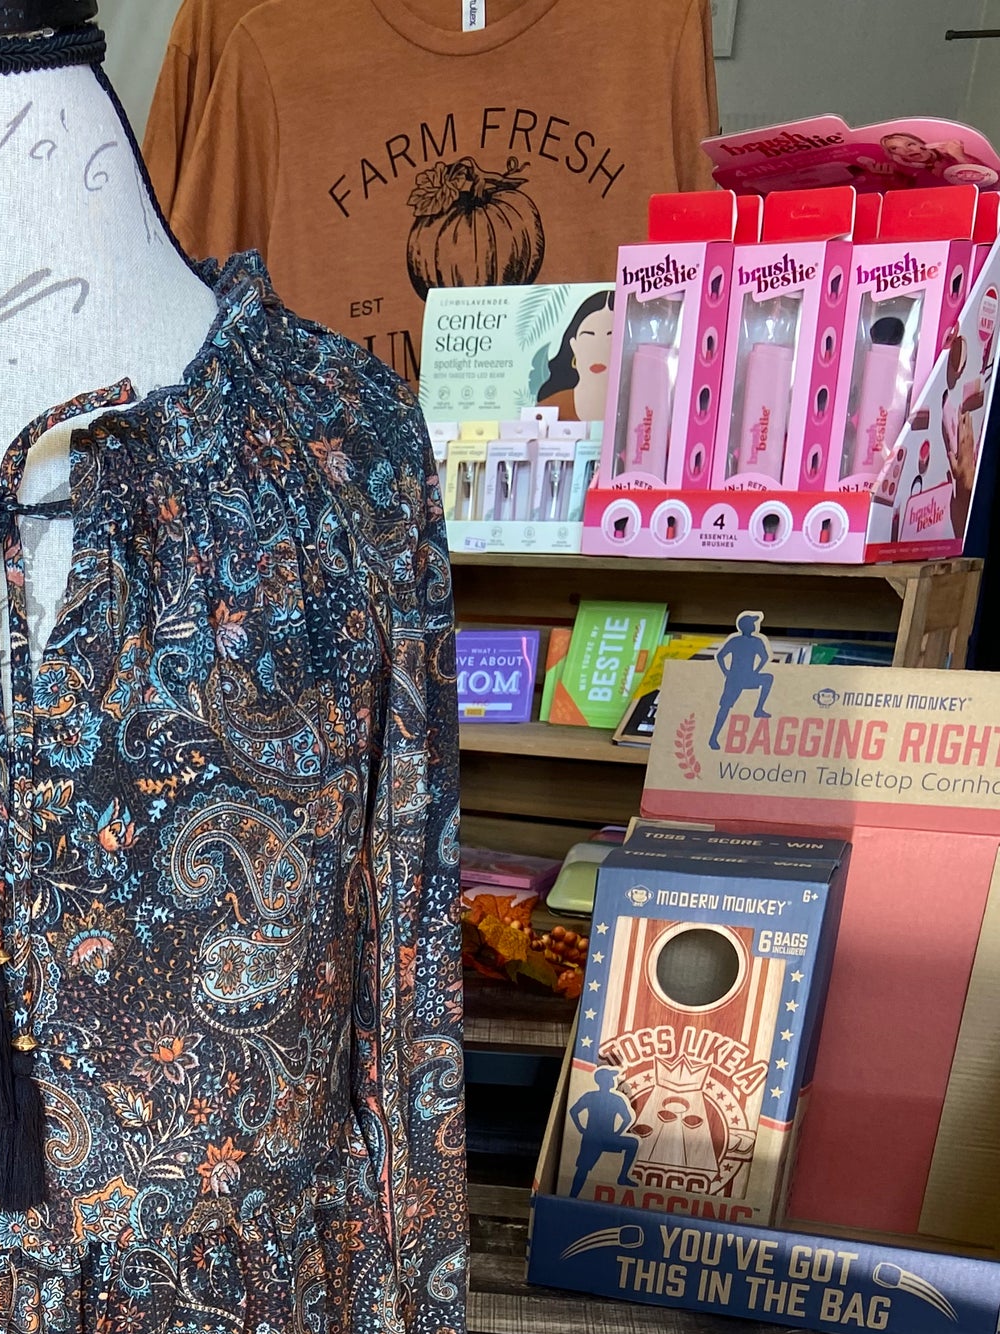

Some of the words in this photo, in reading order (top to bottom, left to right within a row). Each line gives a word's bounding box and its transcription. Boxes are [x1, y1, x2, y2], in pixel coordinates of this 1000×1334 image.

[327, 112, 458, 219] FARM
[479, 107, 626, 199] FRESH
[622, 254, 677, 286] brush
[640, 264, 697, 294] bestie
[738, 253, 796, 286] brush
[756, 264, 815, 294] bestie
[856, 252, 918, 286] brush
[874, 264, 939, 293] bestie
[350, 297, 384, 318] EST
[437, 311, 507, 331] center
[435, 333, 492, 358] stage
[434, 358, 471, 371] spotlight
[473, 359, 514, 369] tweezers
[640, 406, 653, 452] bestie
[756, 405, 770, 451] bestie
[713, 513, 725, 530] 4
[699, 533, 738, 541] ESSENTIAL
[479, 656, 524, 667] ABOUT
[587, 616, 630, 702] BESTIE
[843, 692, 902, 708] MODERN
[906, 695, 967, 711] MONKEY
[724, 714, 889, 760] BAGGING
[719, 761, 807, 785] Wooden
[816, 766, 913, 794] Tabletop
[644, 831, 686, 841] TOSS
[708, 837, 763, 847] SCORE
[787, 842, 824, 850] WIN
[656, 889, 720, 910] MODERN
[722, 894, 787, 916] MONKEY
[802, 889, 819, 903] 6+
[758, 930, 773, 953] 6
[774, 931, 809, 948] BAGS
[600, 1026, 676, 1068] TOSS
[681, 1026, 750, 1077] LIKE
[732, 1060, 769, 1095] A
[659, 1224, 778, 1275] YOU'VE
[788, 1245, 858, 1286] GOT
[616, 1255, 687, 1298] THIS
[697, 1269, 732, 1305] IN
[745, 1276, 810, 1318] THE
[819, 1287, 892, 1331] BAG
